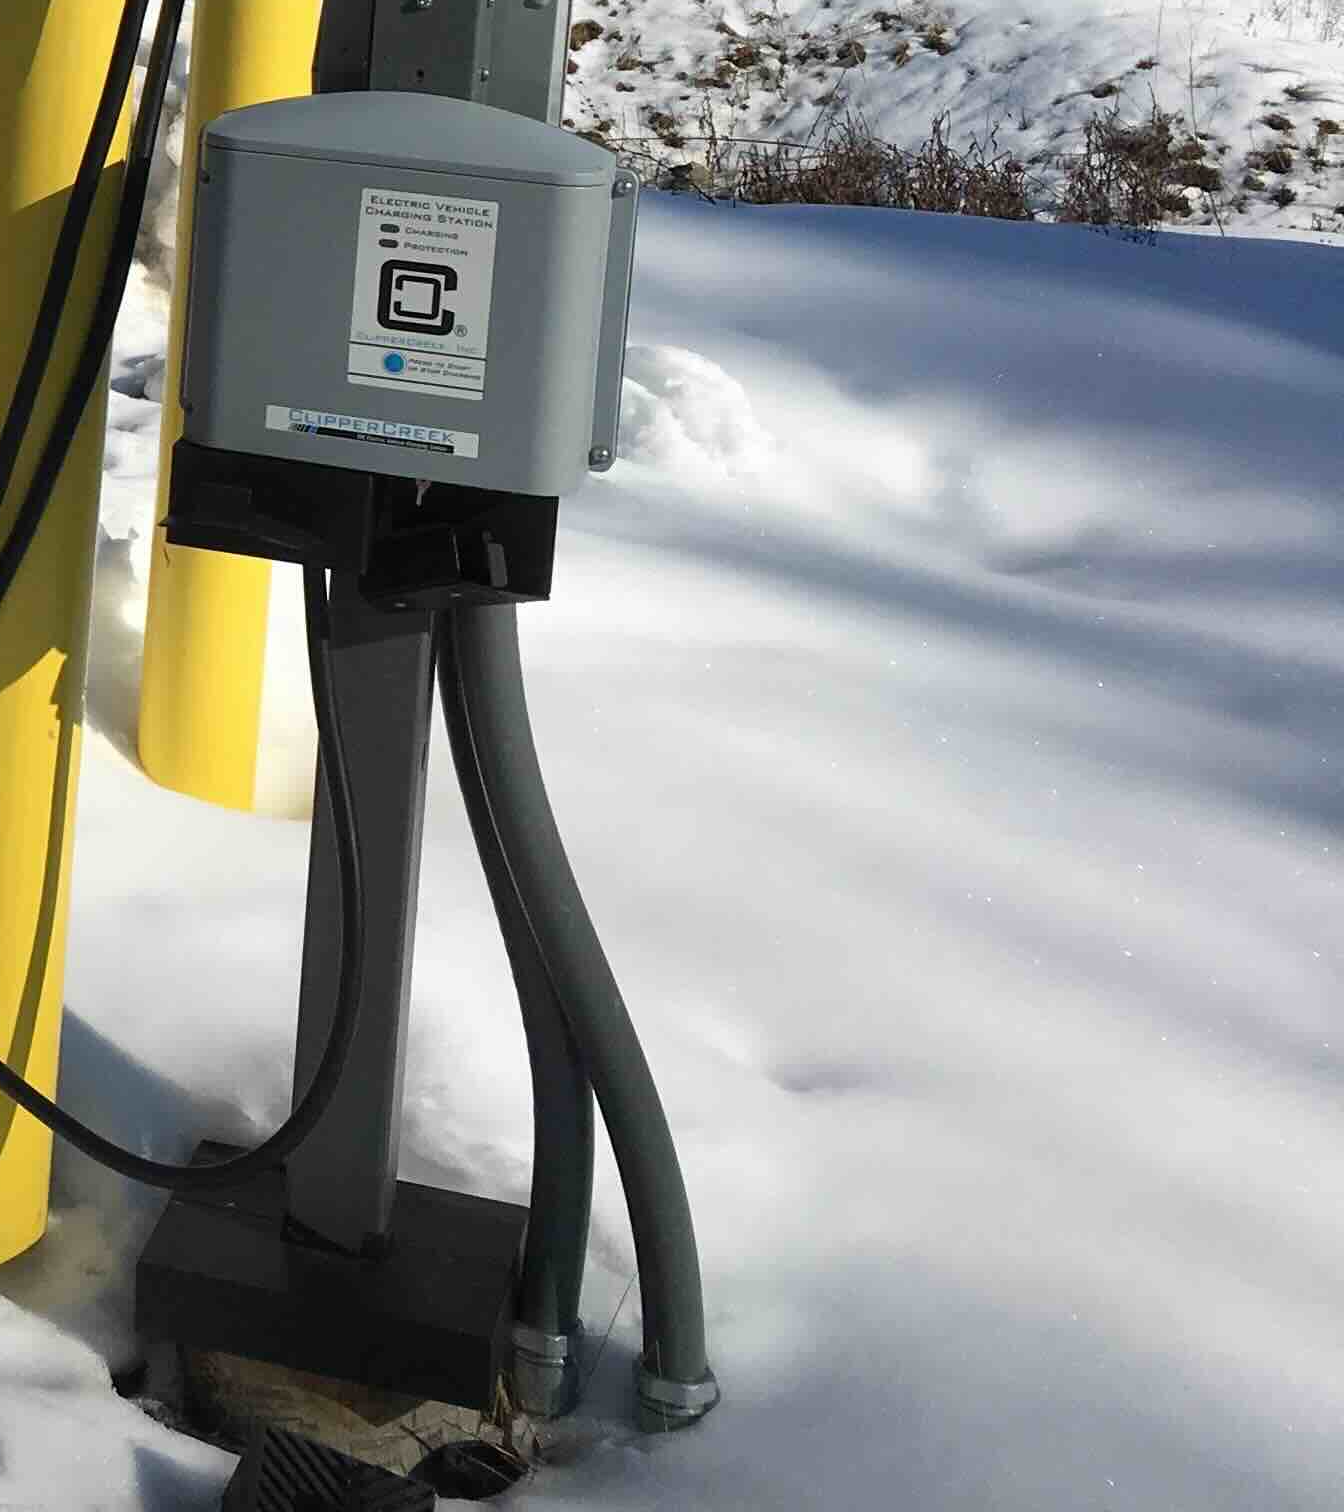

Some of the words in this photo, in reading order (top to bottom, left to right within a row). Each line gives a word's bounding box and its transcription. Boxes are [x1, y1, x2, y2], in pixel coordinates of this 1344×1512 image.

[370, 195, 431, 210] ELECTRIC
[435, 201, 490, 217] VEHICLE
[365, 206, 432, 222] CHARGING
[437, 214, 494, 229] STATION
[404, 226, 459, 240] CHARGING
[403, 241, 468, 256] PROTECTION
[288, 407, 457, 444] CLIPPERCREEK
